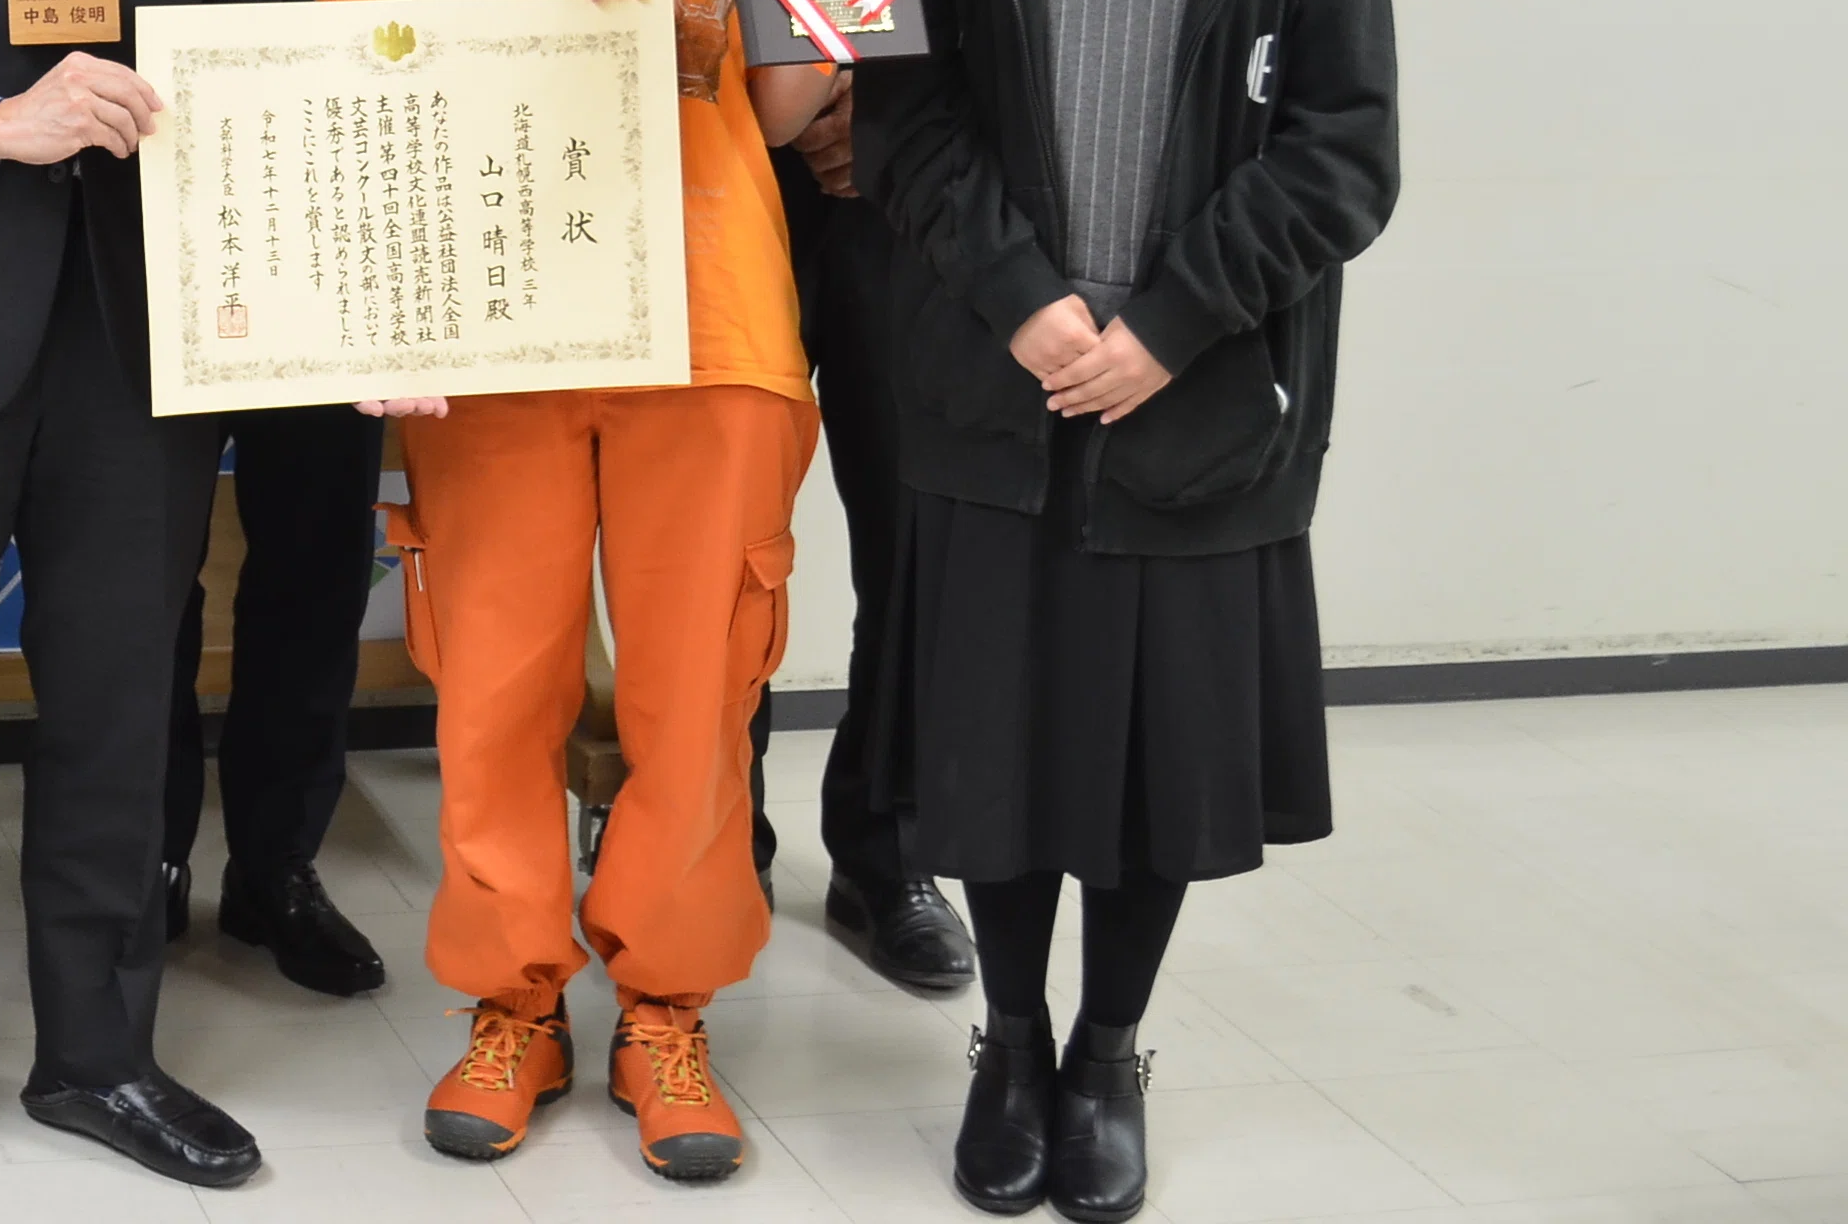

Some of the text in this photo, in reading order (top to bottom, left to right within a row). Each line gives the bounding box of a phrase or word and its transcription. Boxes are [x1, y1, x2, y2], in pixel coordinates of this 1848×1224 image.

[24, 6, 105, 24] 中島 俊明
[219, 117, 235, 197] 文部科学大臣
[259, 109, 281, 277] 令和七年十二月十三日
[302, 98, 324, 292] ここにこれを賞します
[350, 96, 380, 347] 文芸コンクール散文の部において
[404, 92, 437, 344] 高等学校文化連盟読売新聞社
[430, 90, 463, 340] あなたの作品は公益社団法人全国
[561, 137, 598, 245] 賞状
